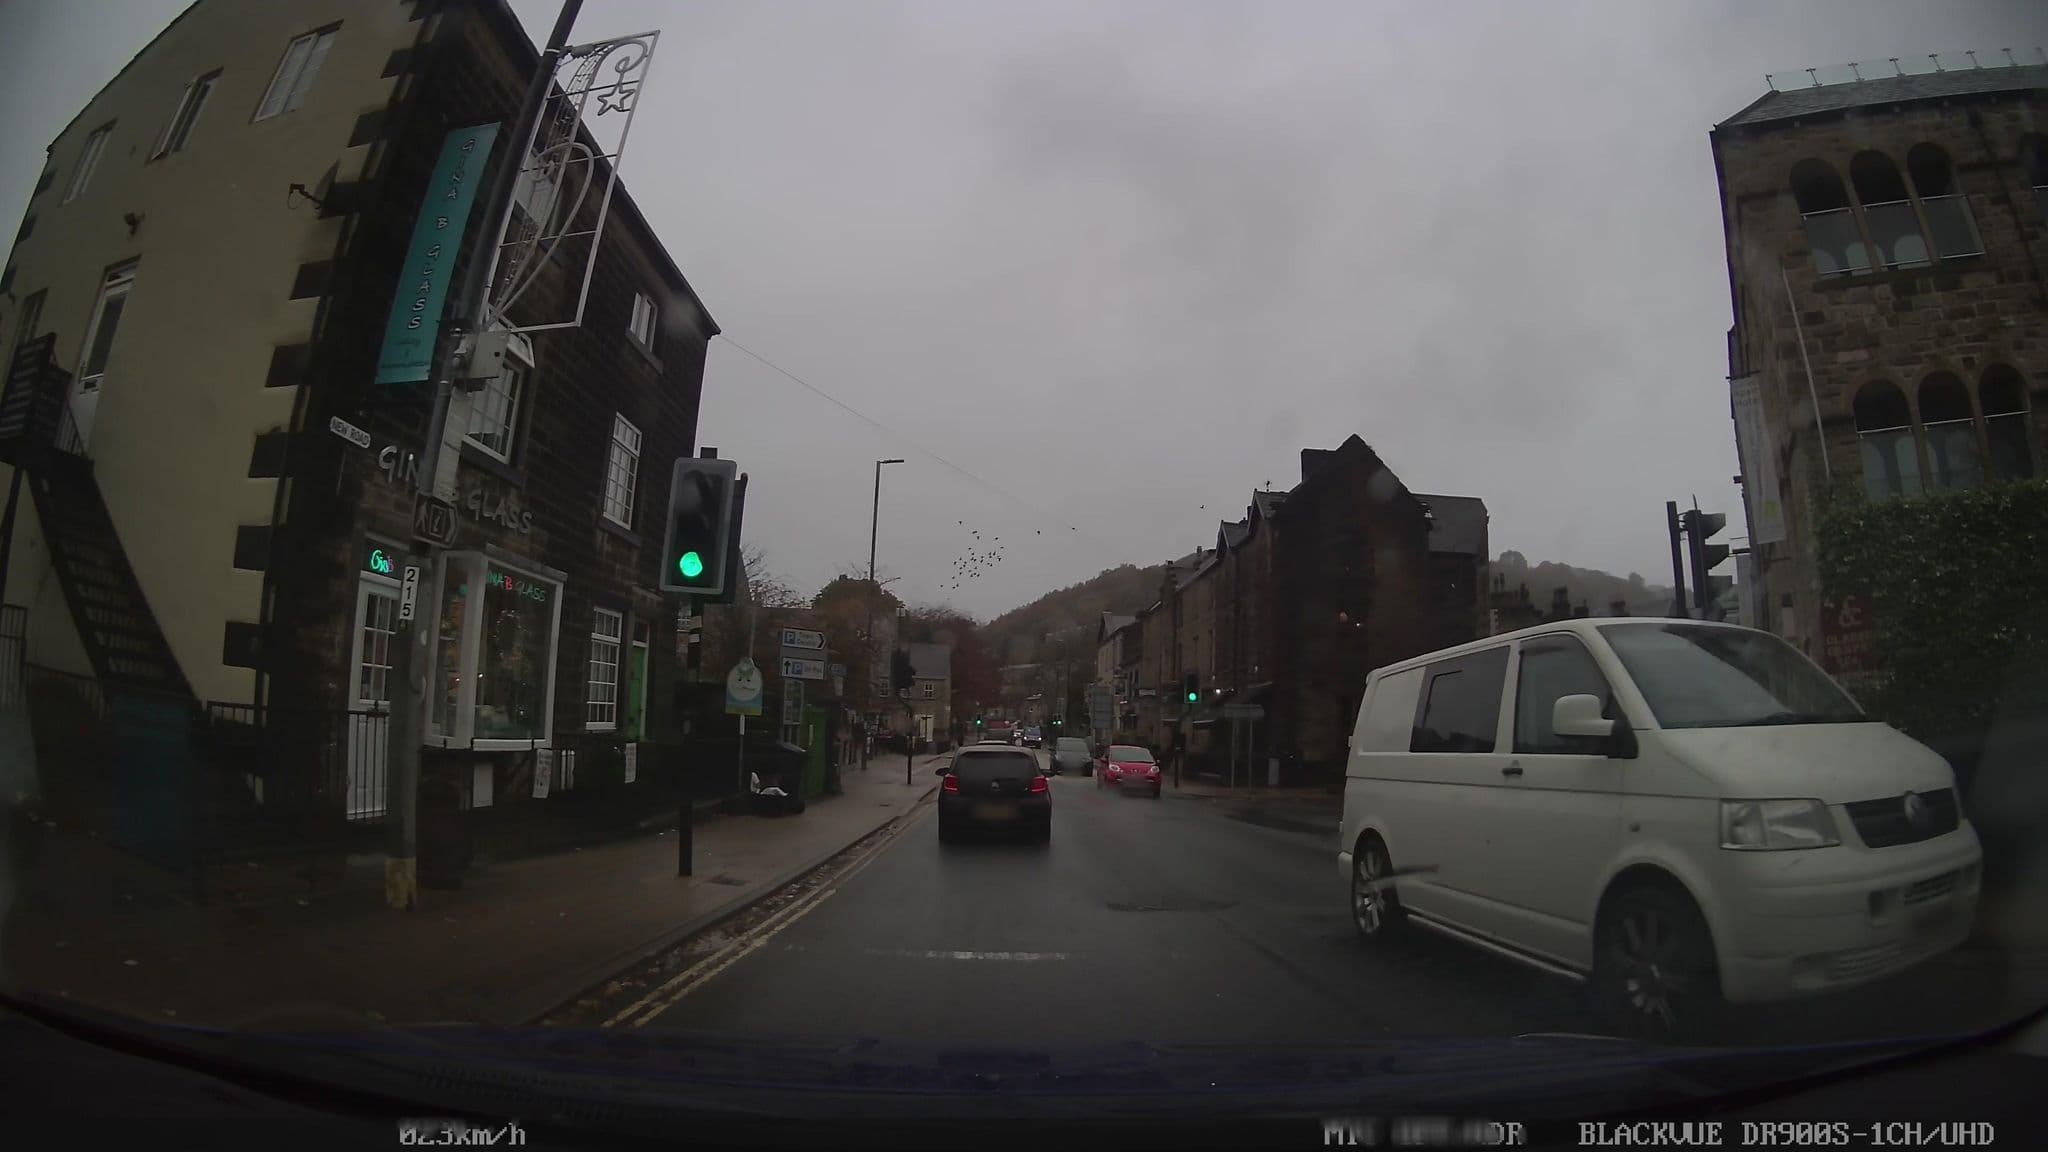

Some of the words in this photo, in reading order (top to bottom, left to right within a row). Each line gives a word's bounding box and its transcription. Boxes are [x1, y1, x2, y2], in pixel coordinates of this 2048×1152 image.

[435, 216, 448, 230] B
[407, 243, 441, 330] GLASS
[332, 419, 349, 436] NEW
[350, 427, 369, 446] ROAD
[466, 489, 534, 534] GLASS
